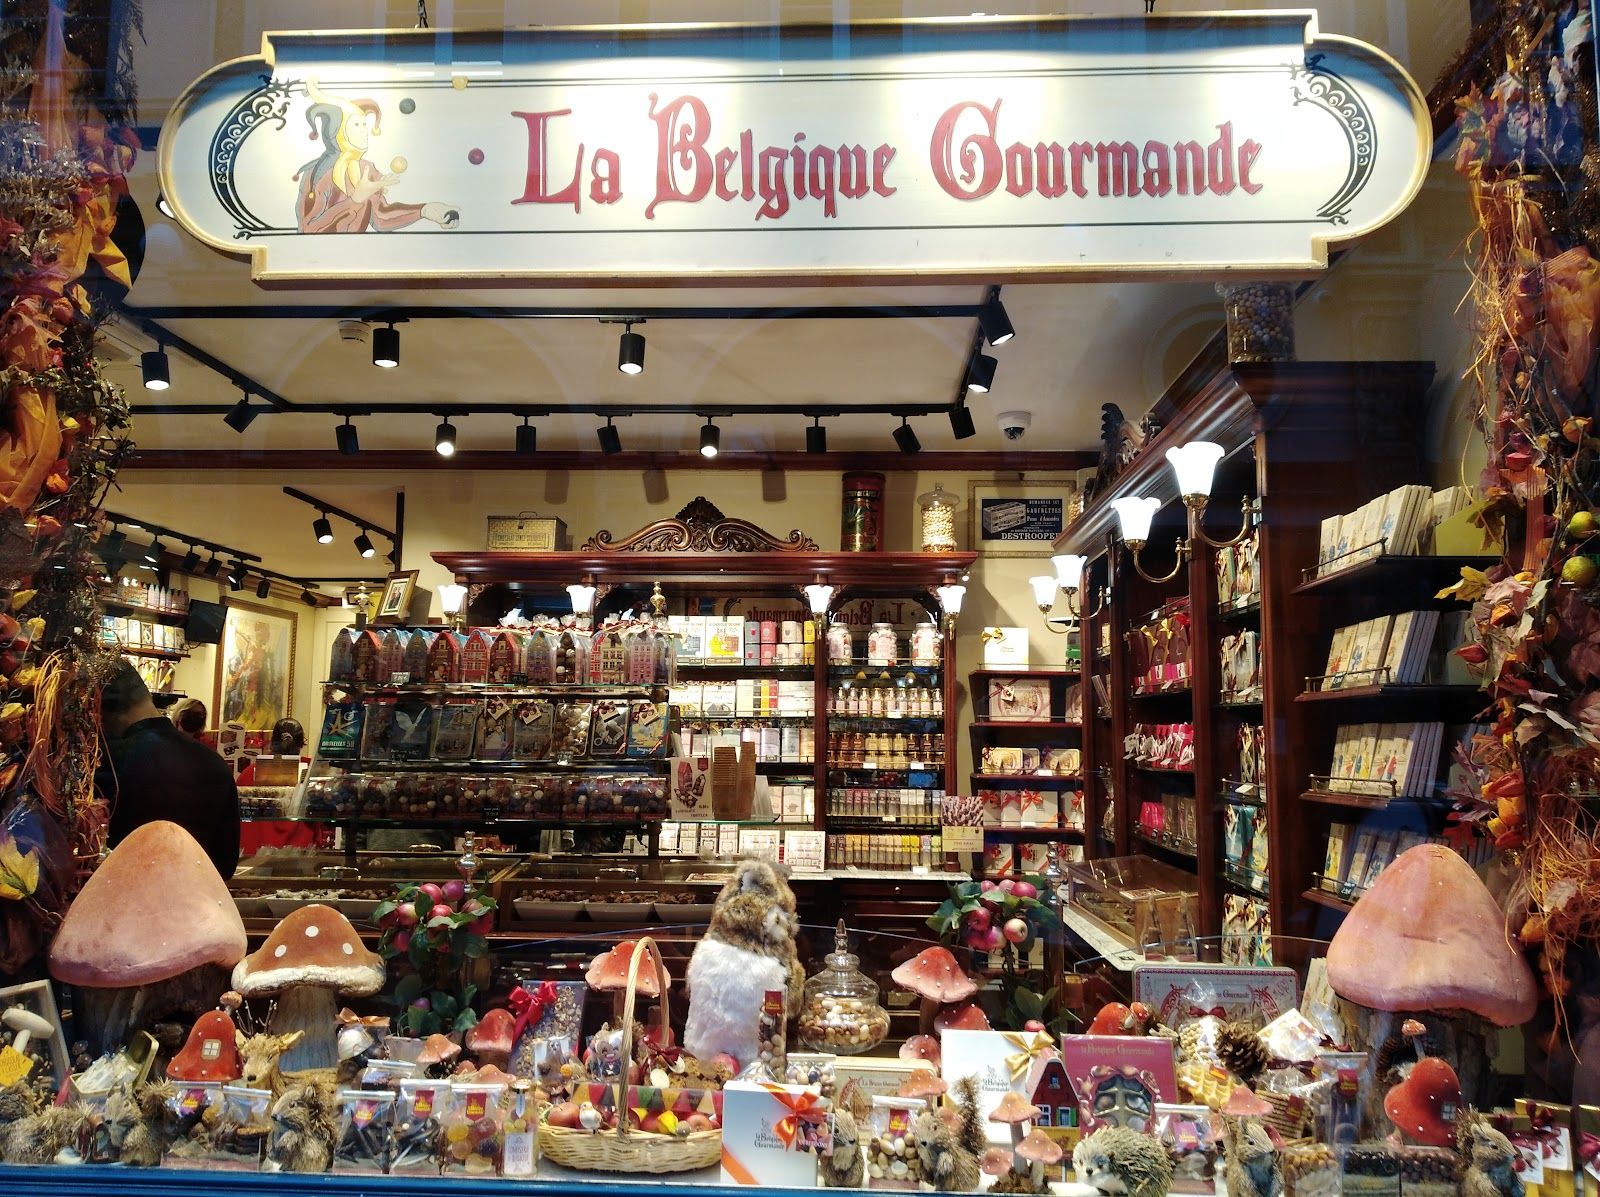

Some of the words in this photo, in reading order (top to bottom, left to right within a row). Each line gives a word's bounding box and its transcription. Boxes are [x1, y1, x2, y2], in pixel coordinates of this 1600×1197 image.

[511, 108, 623, 214] La
[645, 92, 897, 221] Belgique
[930, 97, 1263, 201] Gourmande
